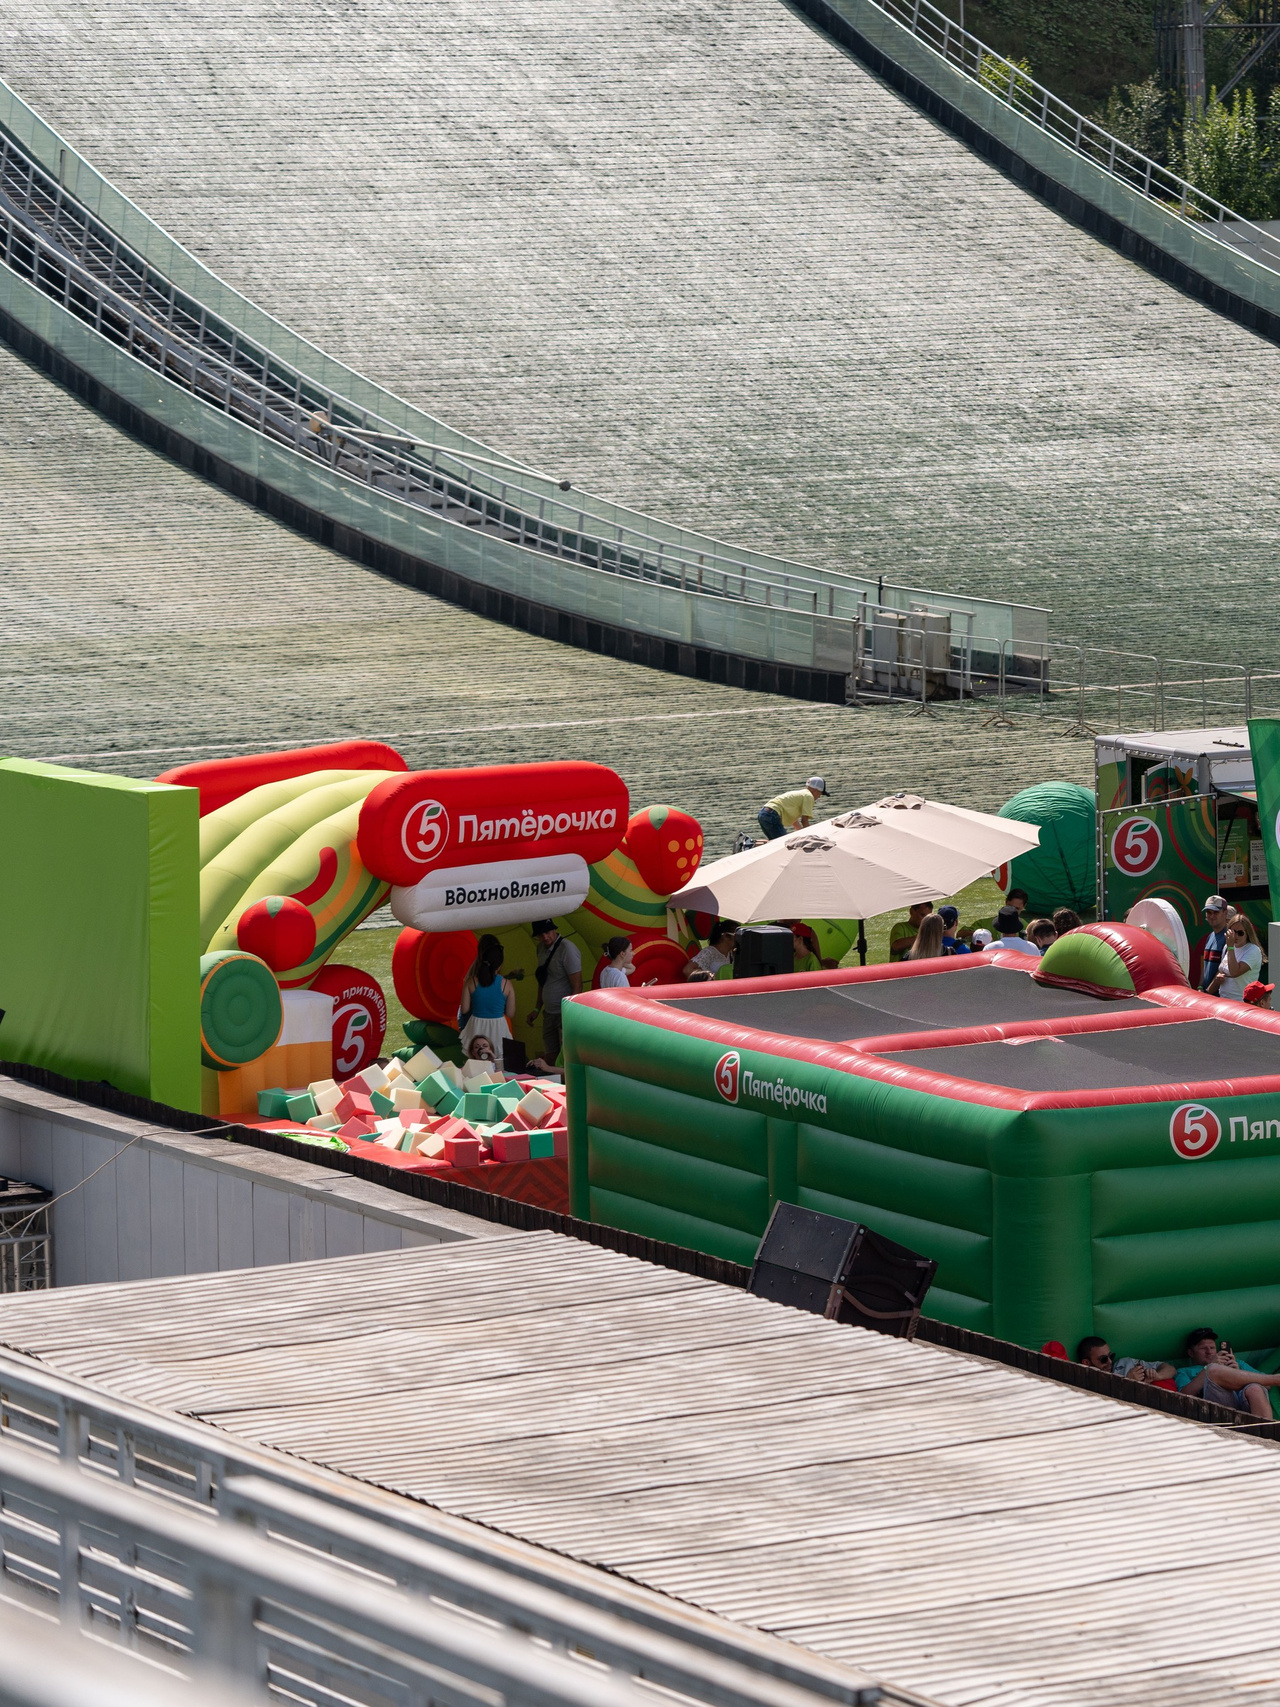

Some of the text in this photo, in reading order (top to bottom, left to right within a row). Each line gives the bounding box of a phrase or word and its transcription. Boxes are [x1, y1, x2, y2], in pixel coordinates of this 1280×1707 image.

[416, 802, 617, 853] 5 Пятёрочка
[1124, 821, 1151, 866] 5
[444, 878, 567, 906] Вдохновляет
[342, 985, 386, 1033] притяжения
[336, 1008, 368, 1073] 5
[720, 1056, 828, 1114] 5 Пятёрочка
[1183, 1106, 1208, 1150] 5
